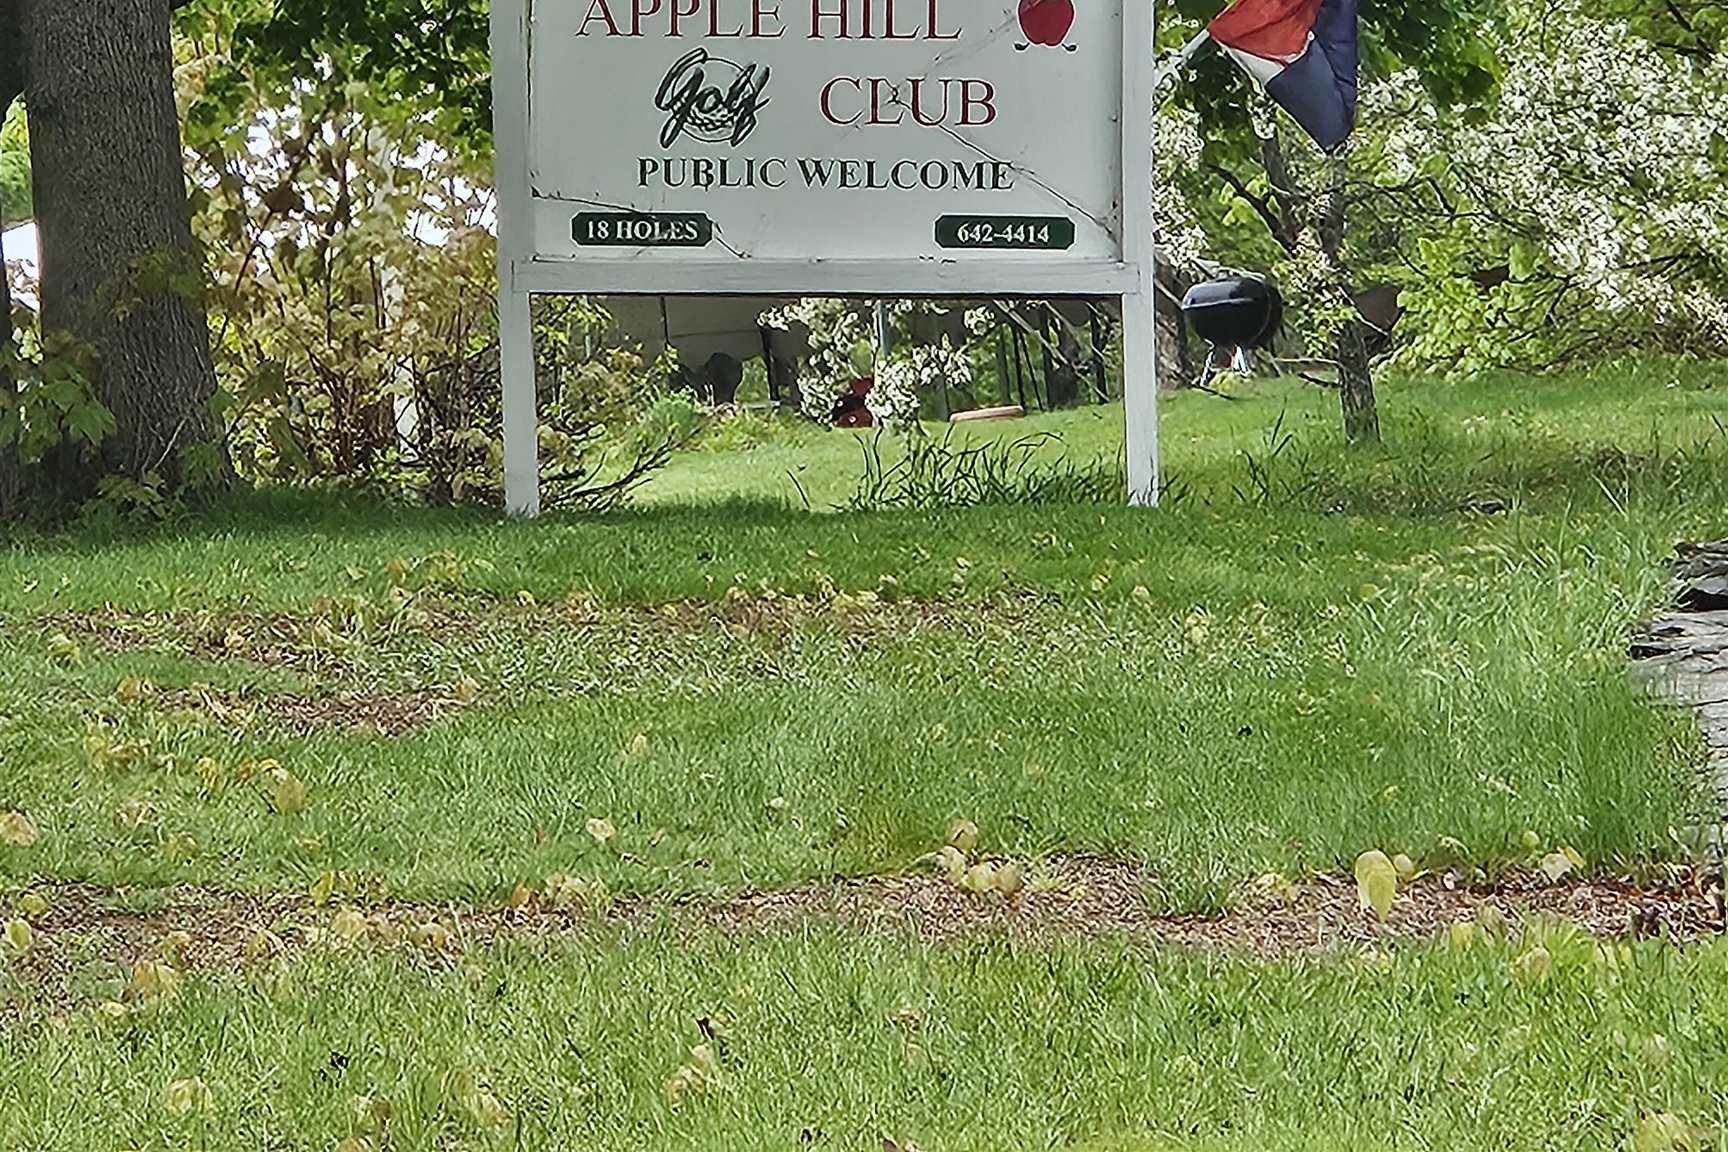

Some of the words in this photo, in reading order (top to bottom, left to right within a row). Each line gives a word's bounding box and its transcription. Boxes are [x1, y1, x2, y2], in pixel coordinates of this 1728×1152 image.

[820, 77, 998, 126] CLUB
[637, 158, 787, 188] PUBLIC
[798, 160, 1014, 191] WELCOME
[588, 220, 609, 239] 18
[616, 220, 698, 240] HOLES
[957, 223, 1049, 243] 642-4414
